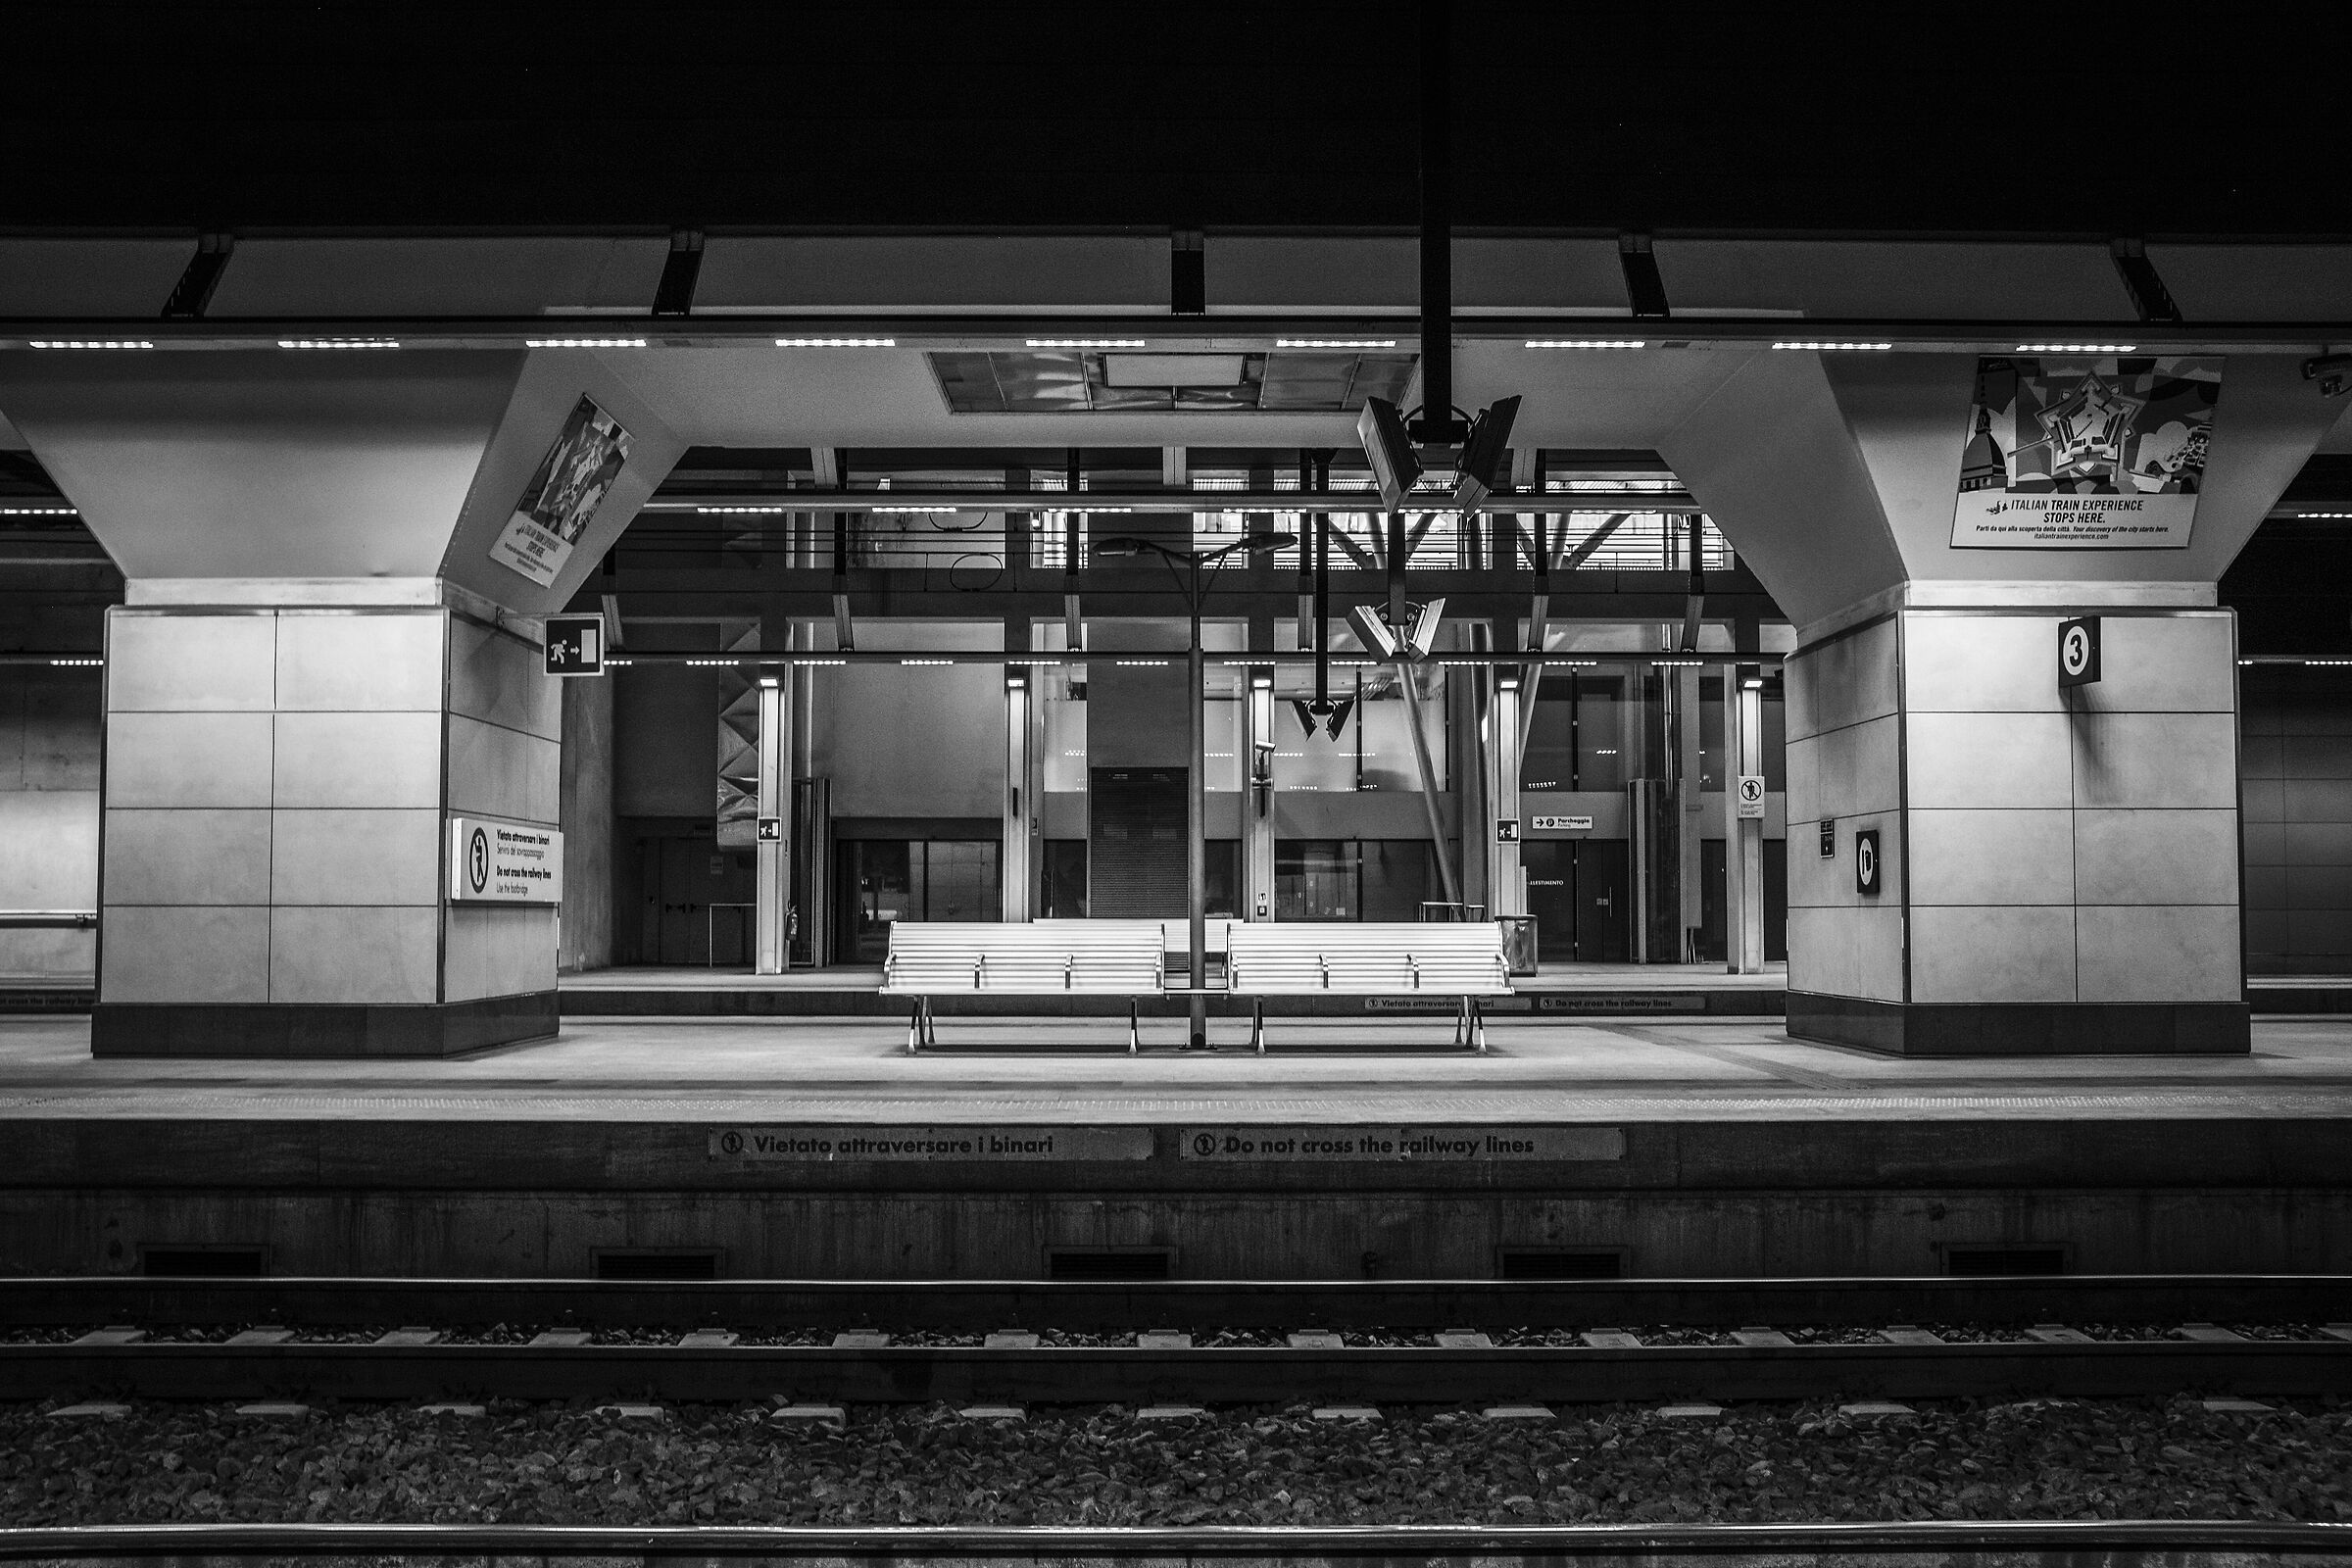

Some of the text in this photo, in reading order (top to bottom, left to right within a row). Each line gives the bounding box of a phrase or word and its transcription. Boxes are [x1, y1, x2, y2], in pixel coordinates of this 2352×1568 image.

[2011, 500, 2144, 511] ITALIAN TRAIN EXPERIENCE
[2043, 513, 2106, 523] STOPS HERE.
[2069, 634, 2082, 667] 3
[497, 829, 512, 841] Vietato
[513, 833, 536, 844] attraversare
[539, 834, 550, 845] binari
[497, 865, 503, 876] Do
[528, 867, 542, 881] railway
[511, 882, 528, 897] footbridge
[1621, 1000, 1651, 1008] railway
[755, 1136, 1053, 1152] Vietato attraversare i binari
[1226, 1135, 1534, 1156] Do not cross the railway lines
